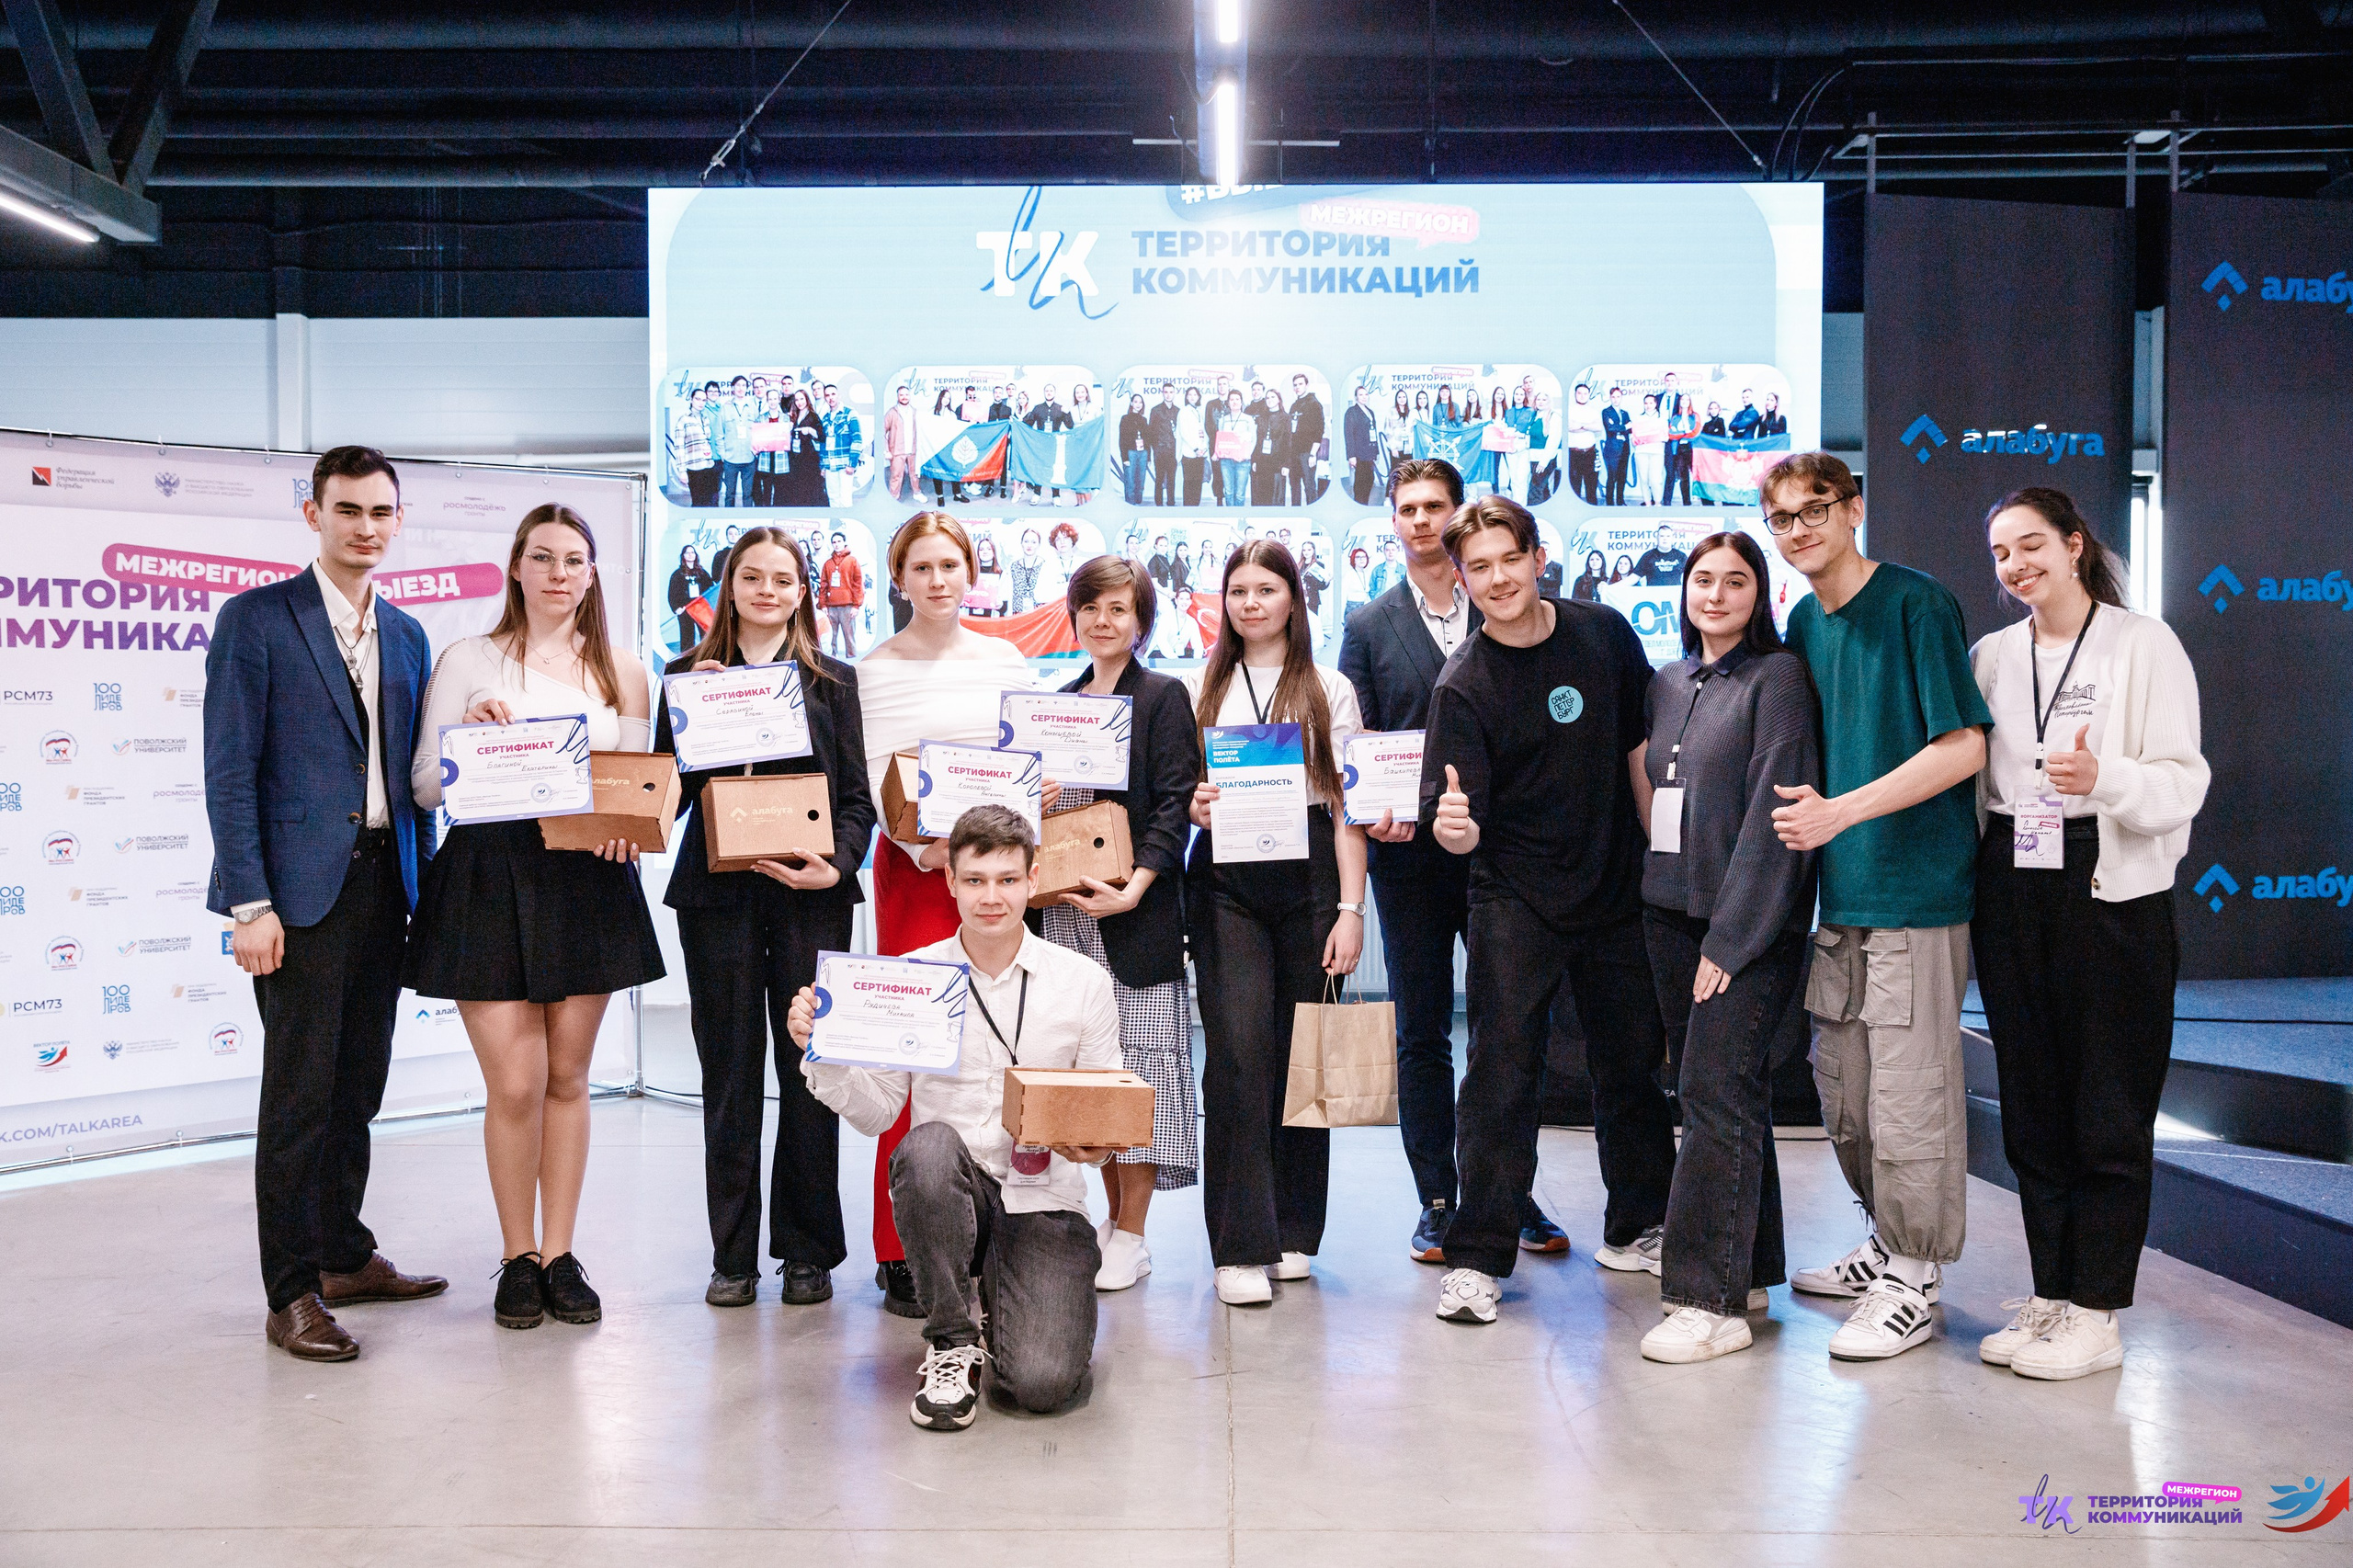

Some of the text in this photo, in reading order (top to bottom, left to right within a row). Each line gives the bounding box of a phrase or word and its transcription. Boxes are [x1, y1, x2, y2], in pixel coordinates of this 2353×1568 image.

[1311, 205, 1470, 234] МЕЖРЕГИОН
[1131, 230, 1391, 257] ТЕРРИТОРИЯ
[1131, 258, 1480, 297] КОММУНИКАЦИЙ
[1960, 423, 2105, 464] алабуга
[56, 467, 96, 477] Федерация
[56, 475, 115, 485] управленческой
[443, 501, 506, 511] росмолодёжь
[374, 572, 460, 600] ЫЕЗД
[0, 618, 210, 652] МУНИКА
[93, 683, 121, 693] 100
[702, 687, 771, 702] СЕРТИФИКАТ
[4, 690, 53, 701] РСМ73
[1551, 690, 1571, 705] САНКТ
[1554, 697, 1575, 712] ПЕТЕР
[1557, 706, 1573, 719] БУРГ
[1031, 714, 1101, 725] СЕРТИФИКАТ
[477, 741, 555, 756] СЕРТИФИКАТ
[1374, 752, 1421, 761] СЕРТИФИ
[948, 766, 1012, 779] СЕРТИФИКАТ
[592, 778, 630, 786] лабуга
[1216, 779, 1293, 789] БЛАГОДАРНОСТЬ
[752, 806, 793, 817] алабуга
[136, 834, 189, 842] ПОВОЛЖСКИЙ
[1044, 838, 1080, 853] алабуга
[139, 935, 192, 945] ПОВОЛЖСКИЙ
[139, 945, 191, 954] УНИВЕРСИТЕТ
[102, 984, 131, 998] 100
[853, 981, 932, 996] СЕРТИФИКАТ
[13, 999, 62, 1013] РСМ73
